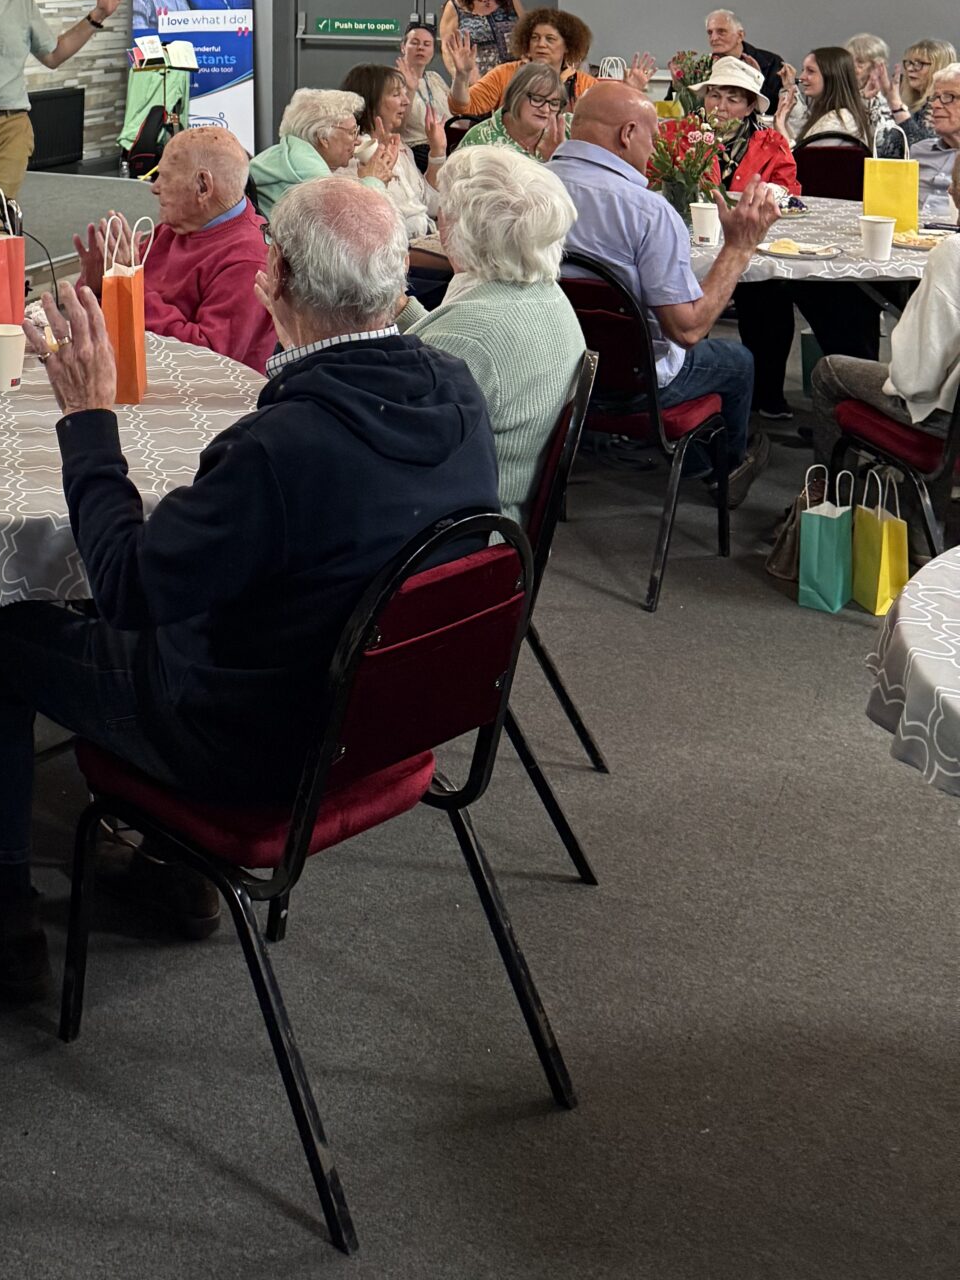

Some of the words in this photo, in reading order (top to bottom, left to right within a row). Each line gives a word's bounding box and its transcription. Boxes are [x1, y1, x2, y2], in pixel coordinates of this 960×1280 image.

[167, 17, 189, 26] love
[191, 16, 220, 25] what
[229, 15, 247, 24] do!
[334, 21, 353, 30] Push
[354, 21, 366, 30] bar
[367, 22, 375, 30] to
[376, 22, 395, 32] open
